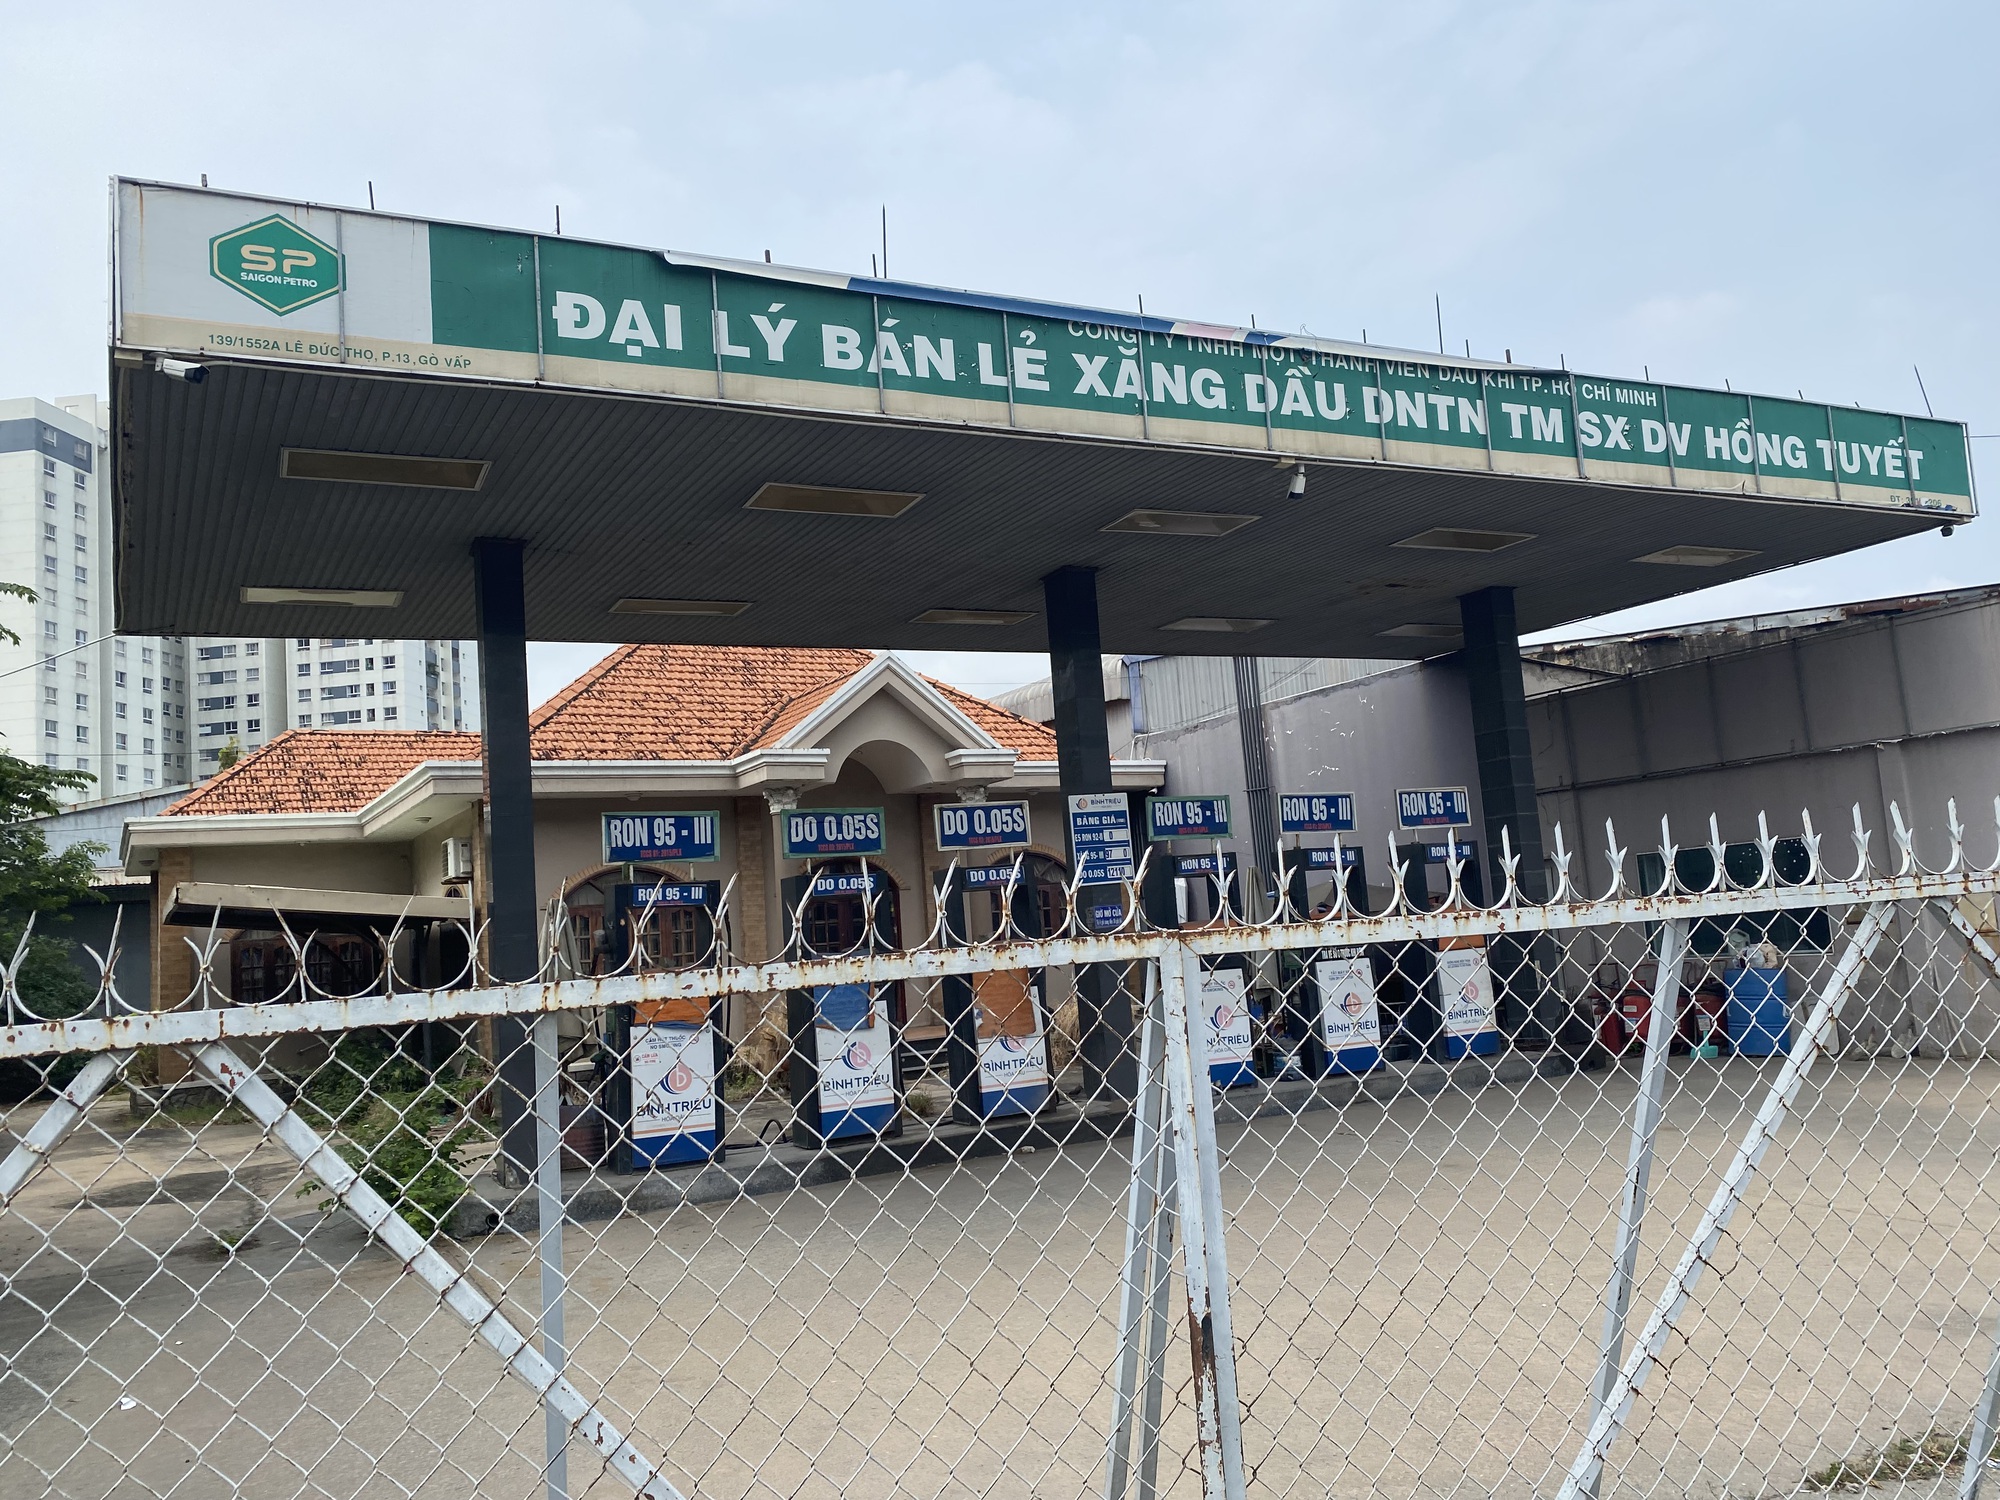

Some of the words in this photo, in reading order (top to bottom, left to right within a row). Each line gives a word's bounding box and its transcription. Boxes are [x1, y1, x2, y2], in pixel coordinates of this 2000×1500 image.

[240, 244, 317, 274] SP
[240, 272, 282, 285] SAIGON
[283, 276, 318, 288] PETRO
[208, 334, 280, 351] 139/1552A
[285, 340, 304, 353] LÊ
[309, 341, 339, 357] ĐỨC
[444, 354, 471, 369] VẤP
[552, 291, 682, 357] ĐẠI
[711, 303, 798, 362] LÝ
[821, 318, 956, 382] BÁN
[977, 330, 1050, 392] LẺ
[1071, 346, 1228, 410] XĂNG
[1244, 365, 1348, 421] DẦU
[1362, 386, 1487, 435] DNTN
[1501, 402, 1564, 443] TM
[1577, 411, 1632, 451] SX
[1641, 419, 1692, 456] DV
[1704, 418, 1808, 469] HỒNG
[1816, 436, 1924, 480] TUYẾT
[1519, 375, 1549, 394] TP.
[1582, 383, 1611, 401] CHÍ
[1615, 387, 1657, 407] MINH
[1155, 801, 1183, 826] RON
[1185, 801, 1203, 824] 95
[1213, 800, 1228, 823] III
[1282, 797, 1309, 821] RON
[1312, 797, 1328, 821] 95
[1338, 797, 1351, 820] III
[1402, 792, 1427, 816] RON
[1429, 792, 1444, 815] 95
[1453, 792, 1466, 813] III
[790, 816, 818, 843] DO
[824, 814, 879, 841] 0.05S
[942, 809, 968, 835] DO
[973, 807, 1025, 834] 0.05S
[1102, 814, 1117, 824] GIÁ
[610, 818, 648, 848] RON
[653, 817, 676, 846] 95
[694, 816, 712, 844] III
[1200, 858, 1211, 868] 95
[1312, 851, 1328, 862] RON
[1431, 846, 1446, 857] RON
[817, 878, 834, 891] DO
[970, 870, 986, 882] DO
[665, 887, 680, 900] 95
[691, 887, 702, 899] III
